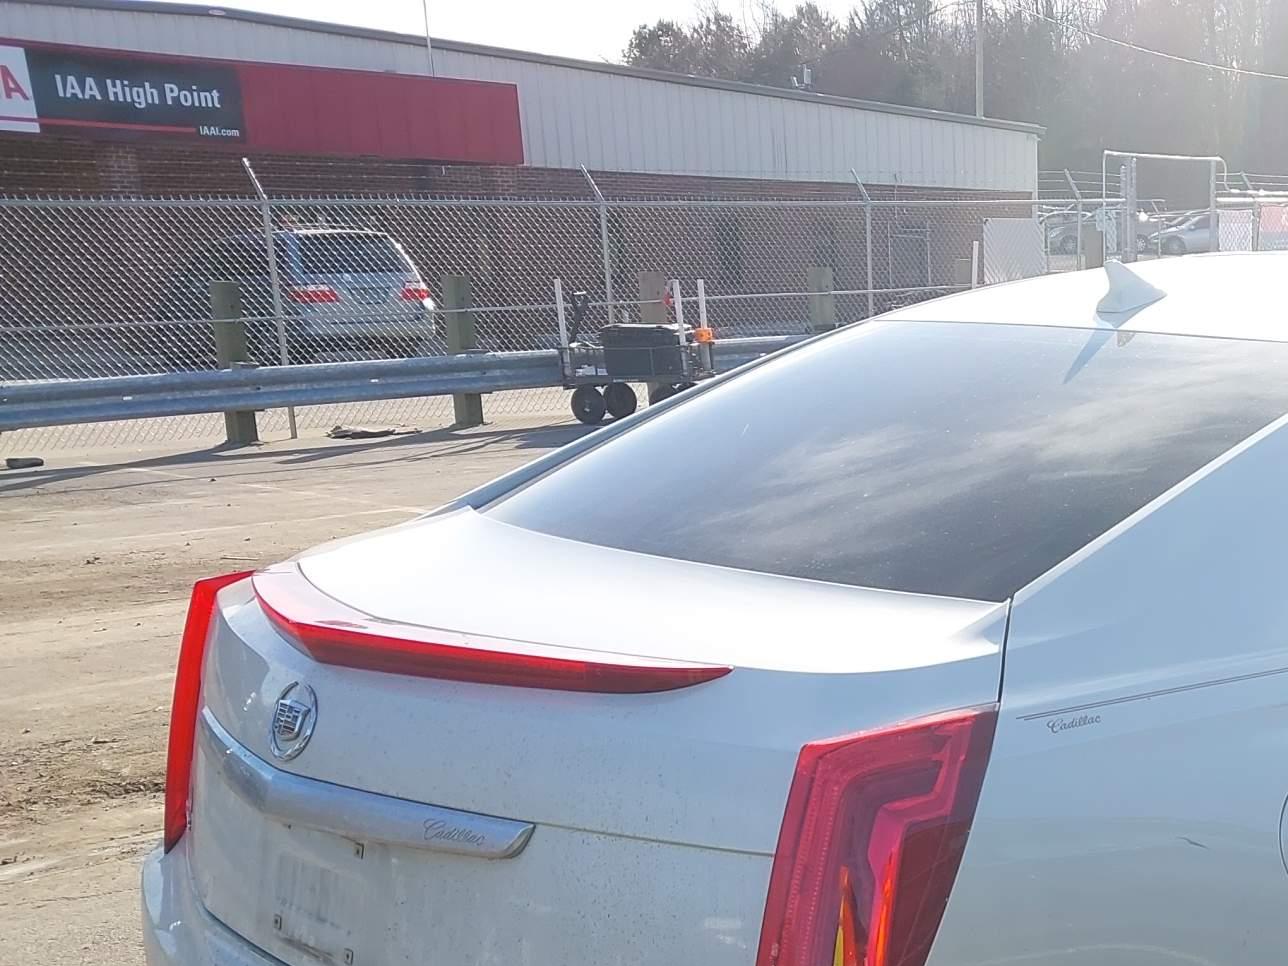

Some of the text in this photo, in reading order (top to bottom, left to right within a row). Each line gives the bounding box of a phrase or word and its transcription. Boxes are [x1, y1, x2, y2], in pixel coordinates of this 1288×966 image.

[54, 73, 221, 109] IAA High Point
[199, 125, 240, 138] IAAI.com
[1046, 714, 1101, 734] Cadillac
[423, 818, 486, 847] Cadillac
